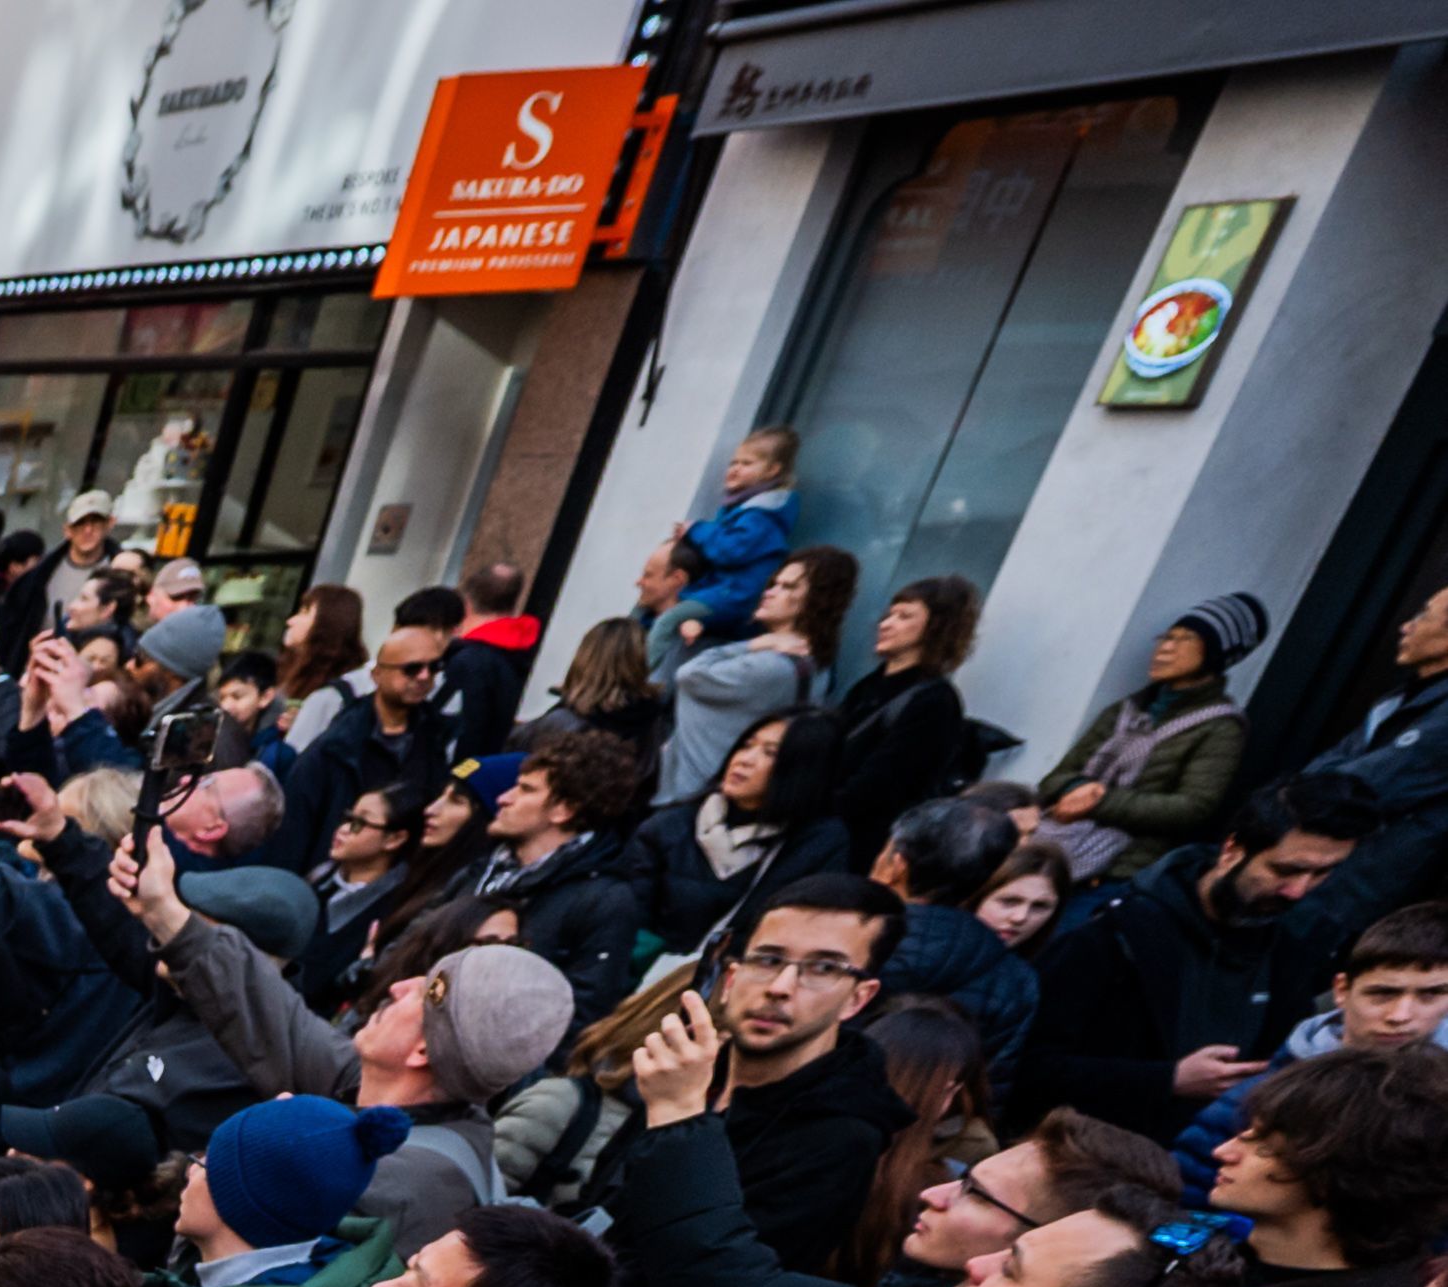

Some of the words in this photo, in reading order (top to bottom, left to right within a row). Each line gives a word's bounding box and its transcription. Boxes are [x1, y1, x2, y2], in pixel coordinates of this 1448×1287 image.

[501, 90, 564, 171] S
[449, 173, 585, 202] SAKURA-DO
[428, 219, 576, 252] JAPANESE
[409, 257, 485, 274] PREMIUM
